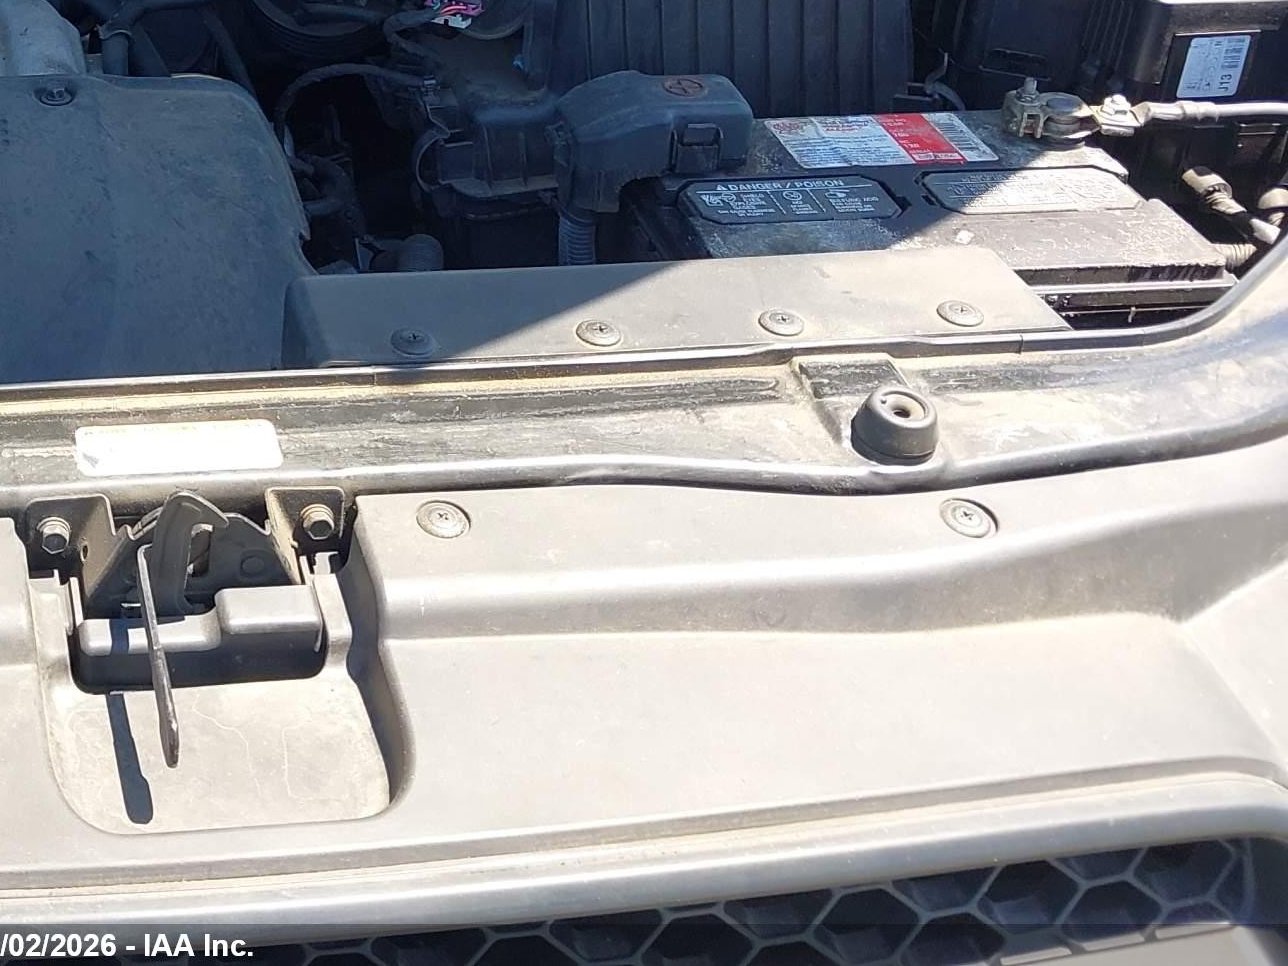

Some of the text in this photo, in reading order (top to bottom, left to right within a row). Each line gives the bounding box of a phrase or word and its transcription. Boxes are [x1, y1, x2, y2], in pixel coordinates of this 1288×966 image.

[1217, 73, 1233, 92] J13
[727, 181, 782, 191] DANGER
[794, 179, 845, 188] POISON
